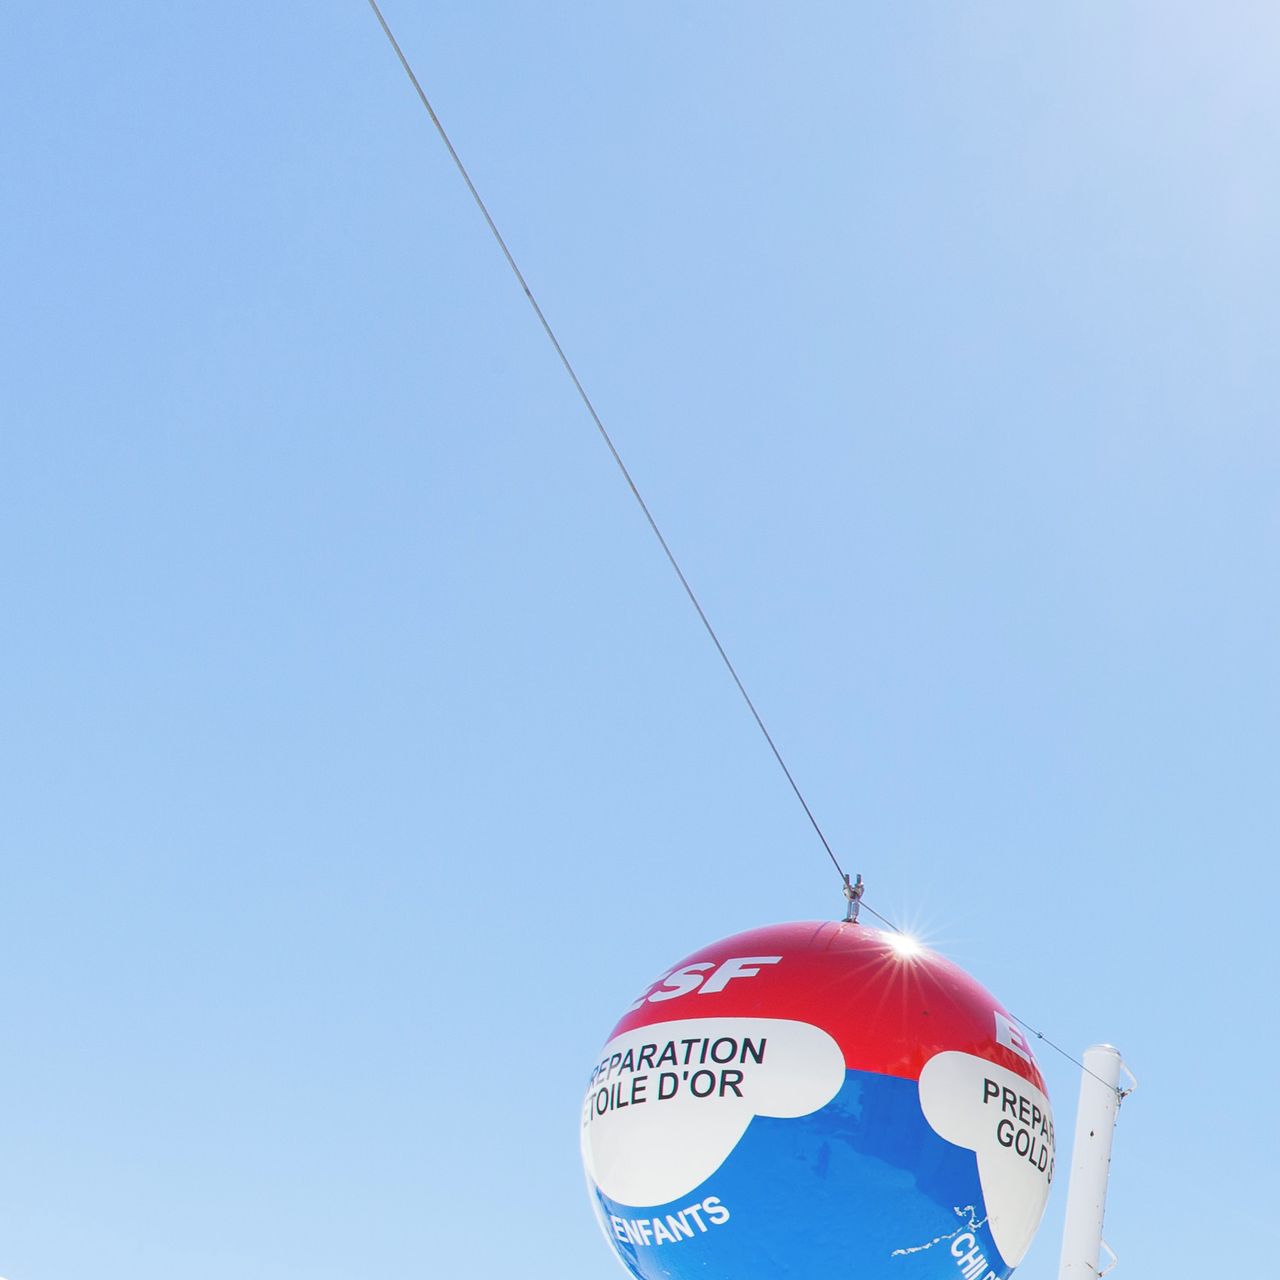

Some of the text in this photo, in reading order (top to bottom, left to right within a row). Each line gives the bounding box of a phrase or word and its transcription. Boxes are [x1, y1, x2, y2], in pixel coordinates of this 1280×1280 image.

[657, 1068, 744, 1101] D'OR
[997, 1119, 1048, 1173] GOLD
[610, 1196, 730, 1246] ENFANTS
